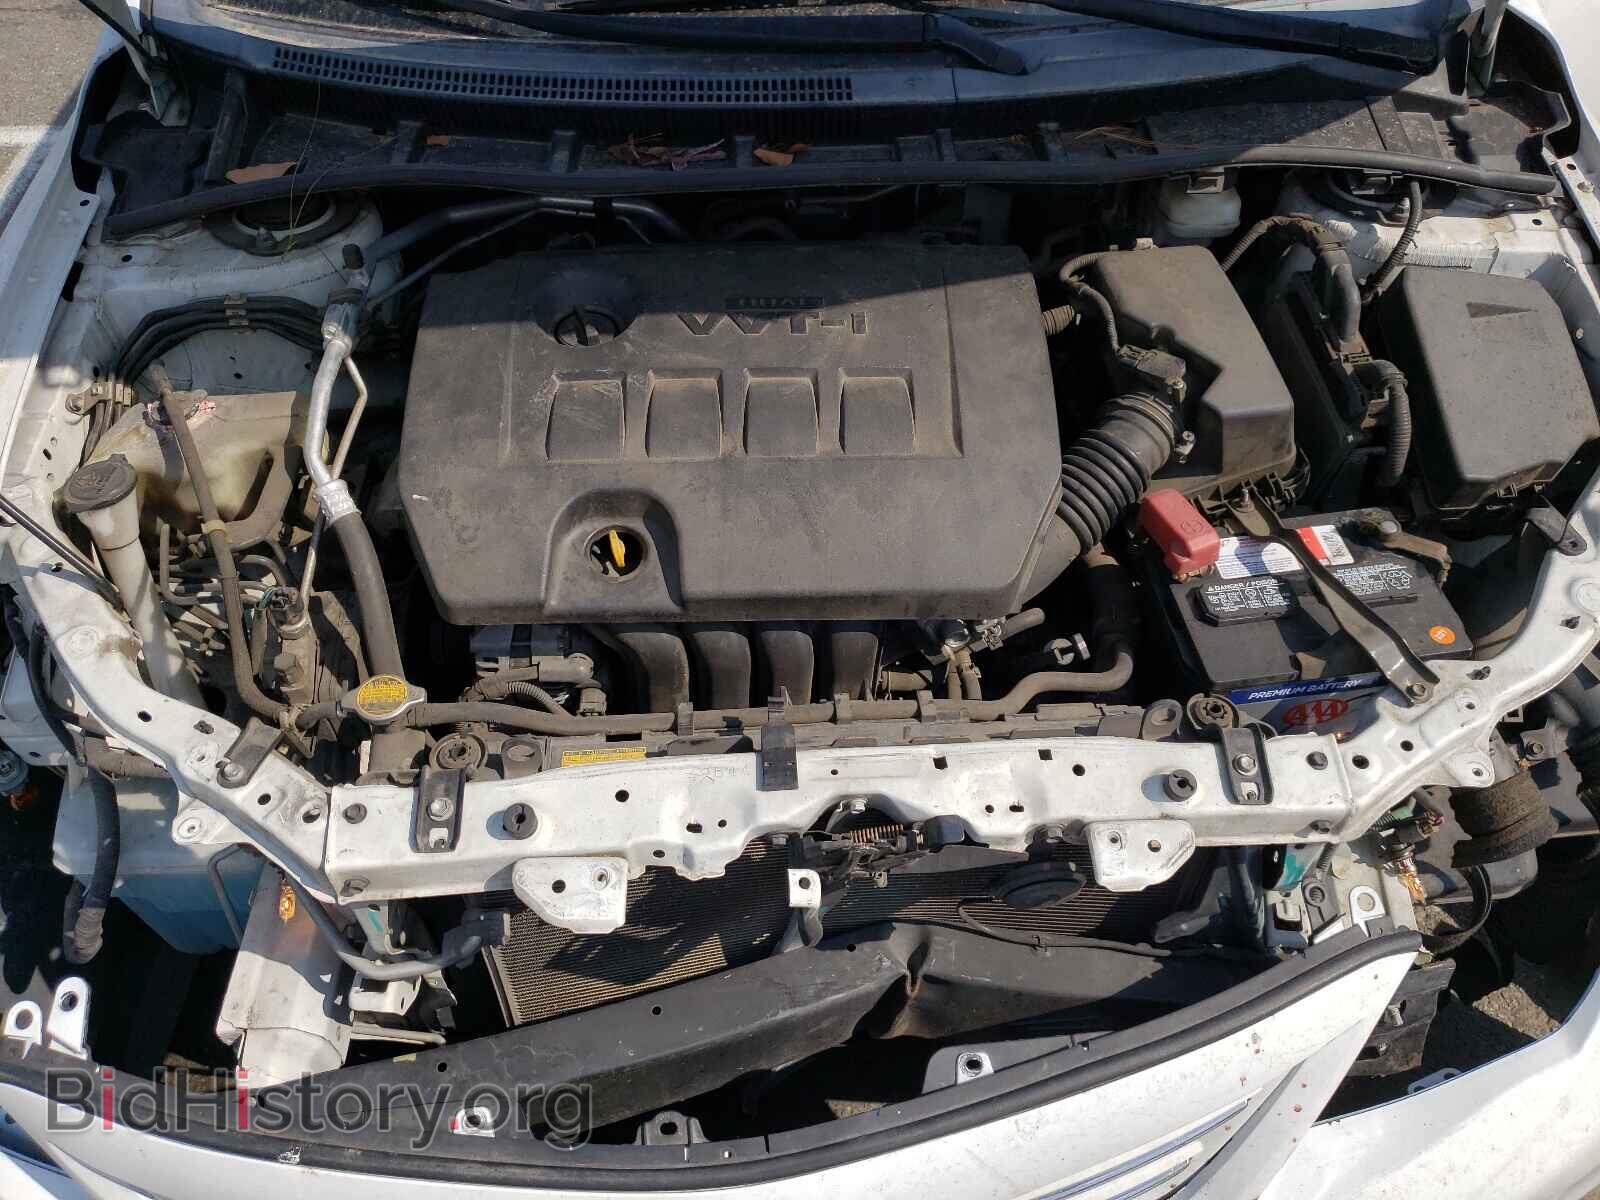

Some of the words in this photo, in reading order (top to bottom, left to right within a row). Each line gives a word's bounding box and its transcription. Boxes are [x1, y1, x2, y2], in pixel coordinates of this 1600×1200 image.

[1214, 582, 1245, 592] DANGER
[1247, 685, 1306, 700] PREMIUM
[1308, 679, 1364, 693] BATTERY
